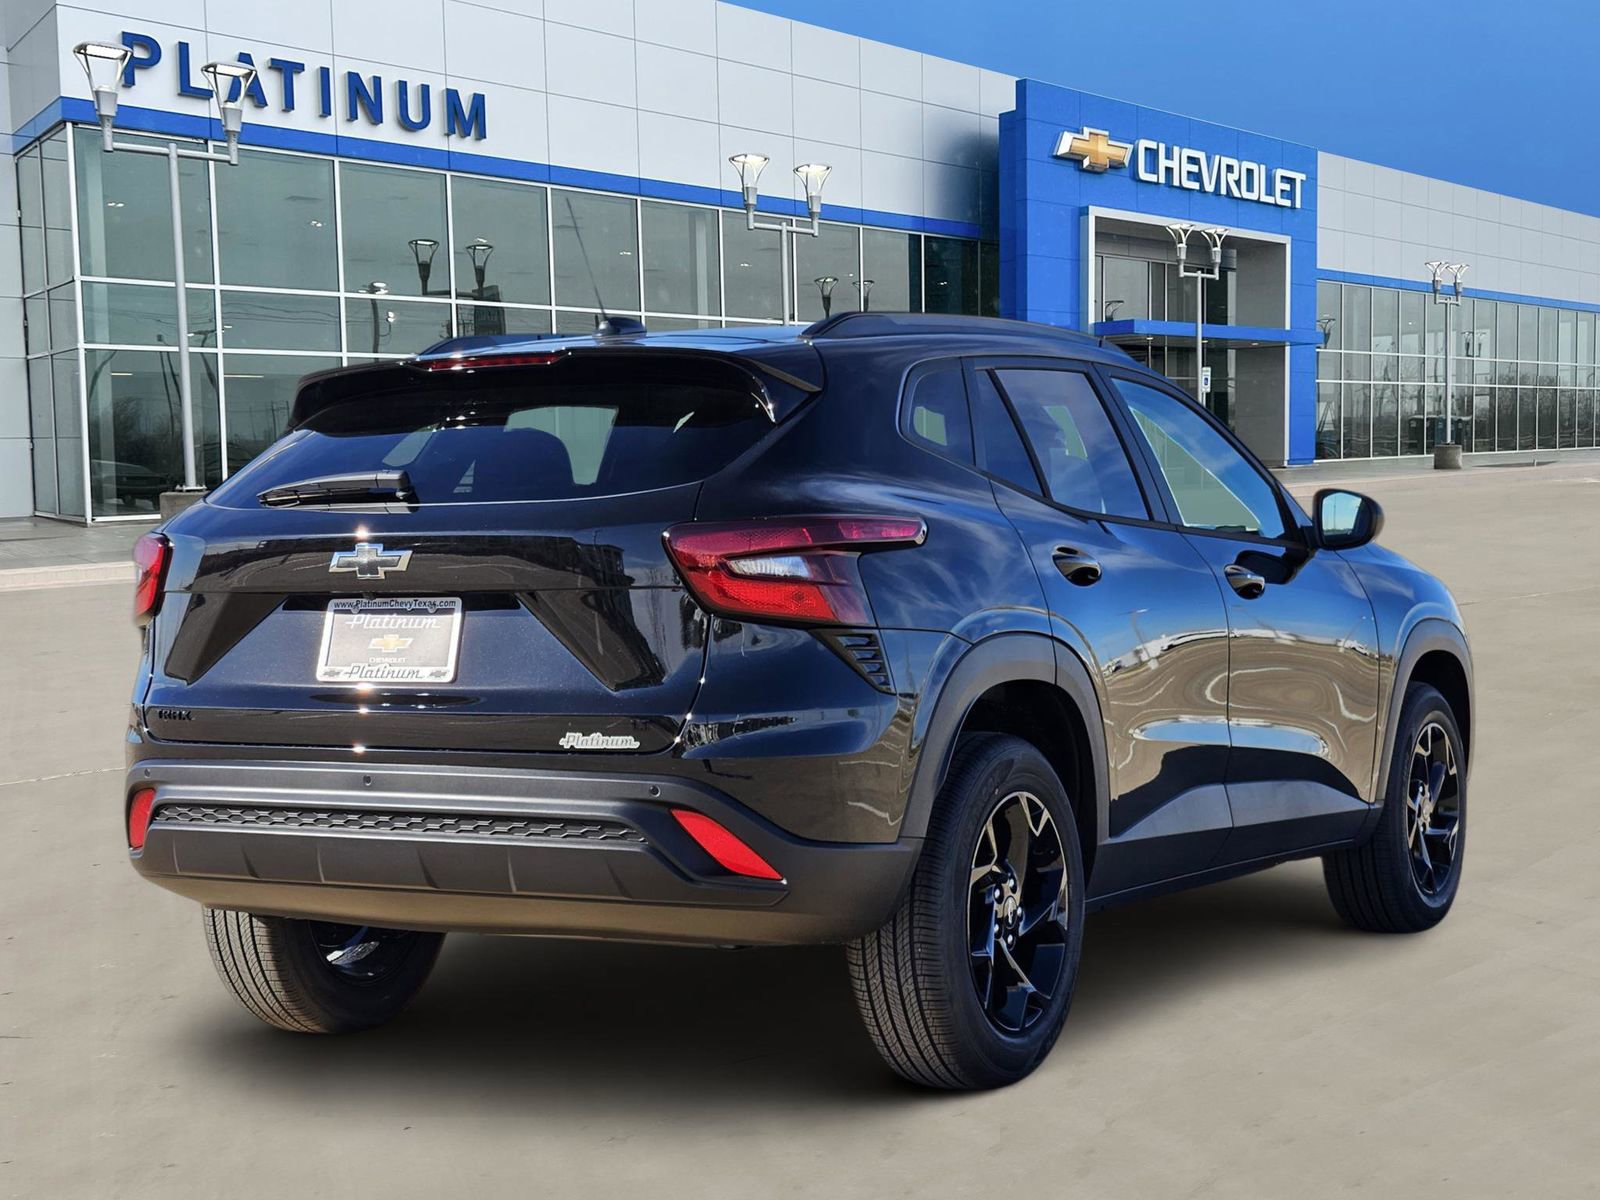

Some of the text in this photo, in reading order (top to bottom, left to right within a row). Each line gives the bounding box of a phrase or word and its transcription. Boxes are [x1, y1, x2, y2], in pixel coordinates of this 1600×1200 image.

[120, 30, 487, 141] PLATINUM
[1135, 138, 1306, 208] CHEVROLET
[345, 612, 441, 629] Platinum
[344, 663, 425, 679] Platinum
[559, 732, 640, 749] Platinum
